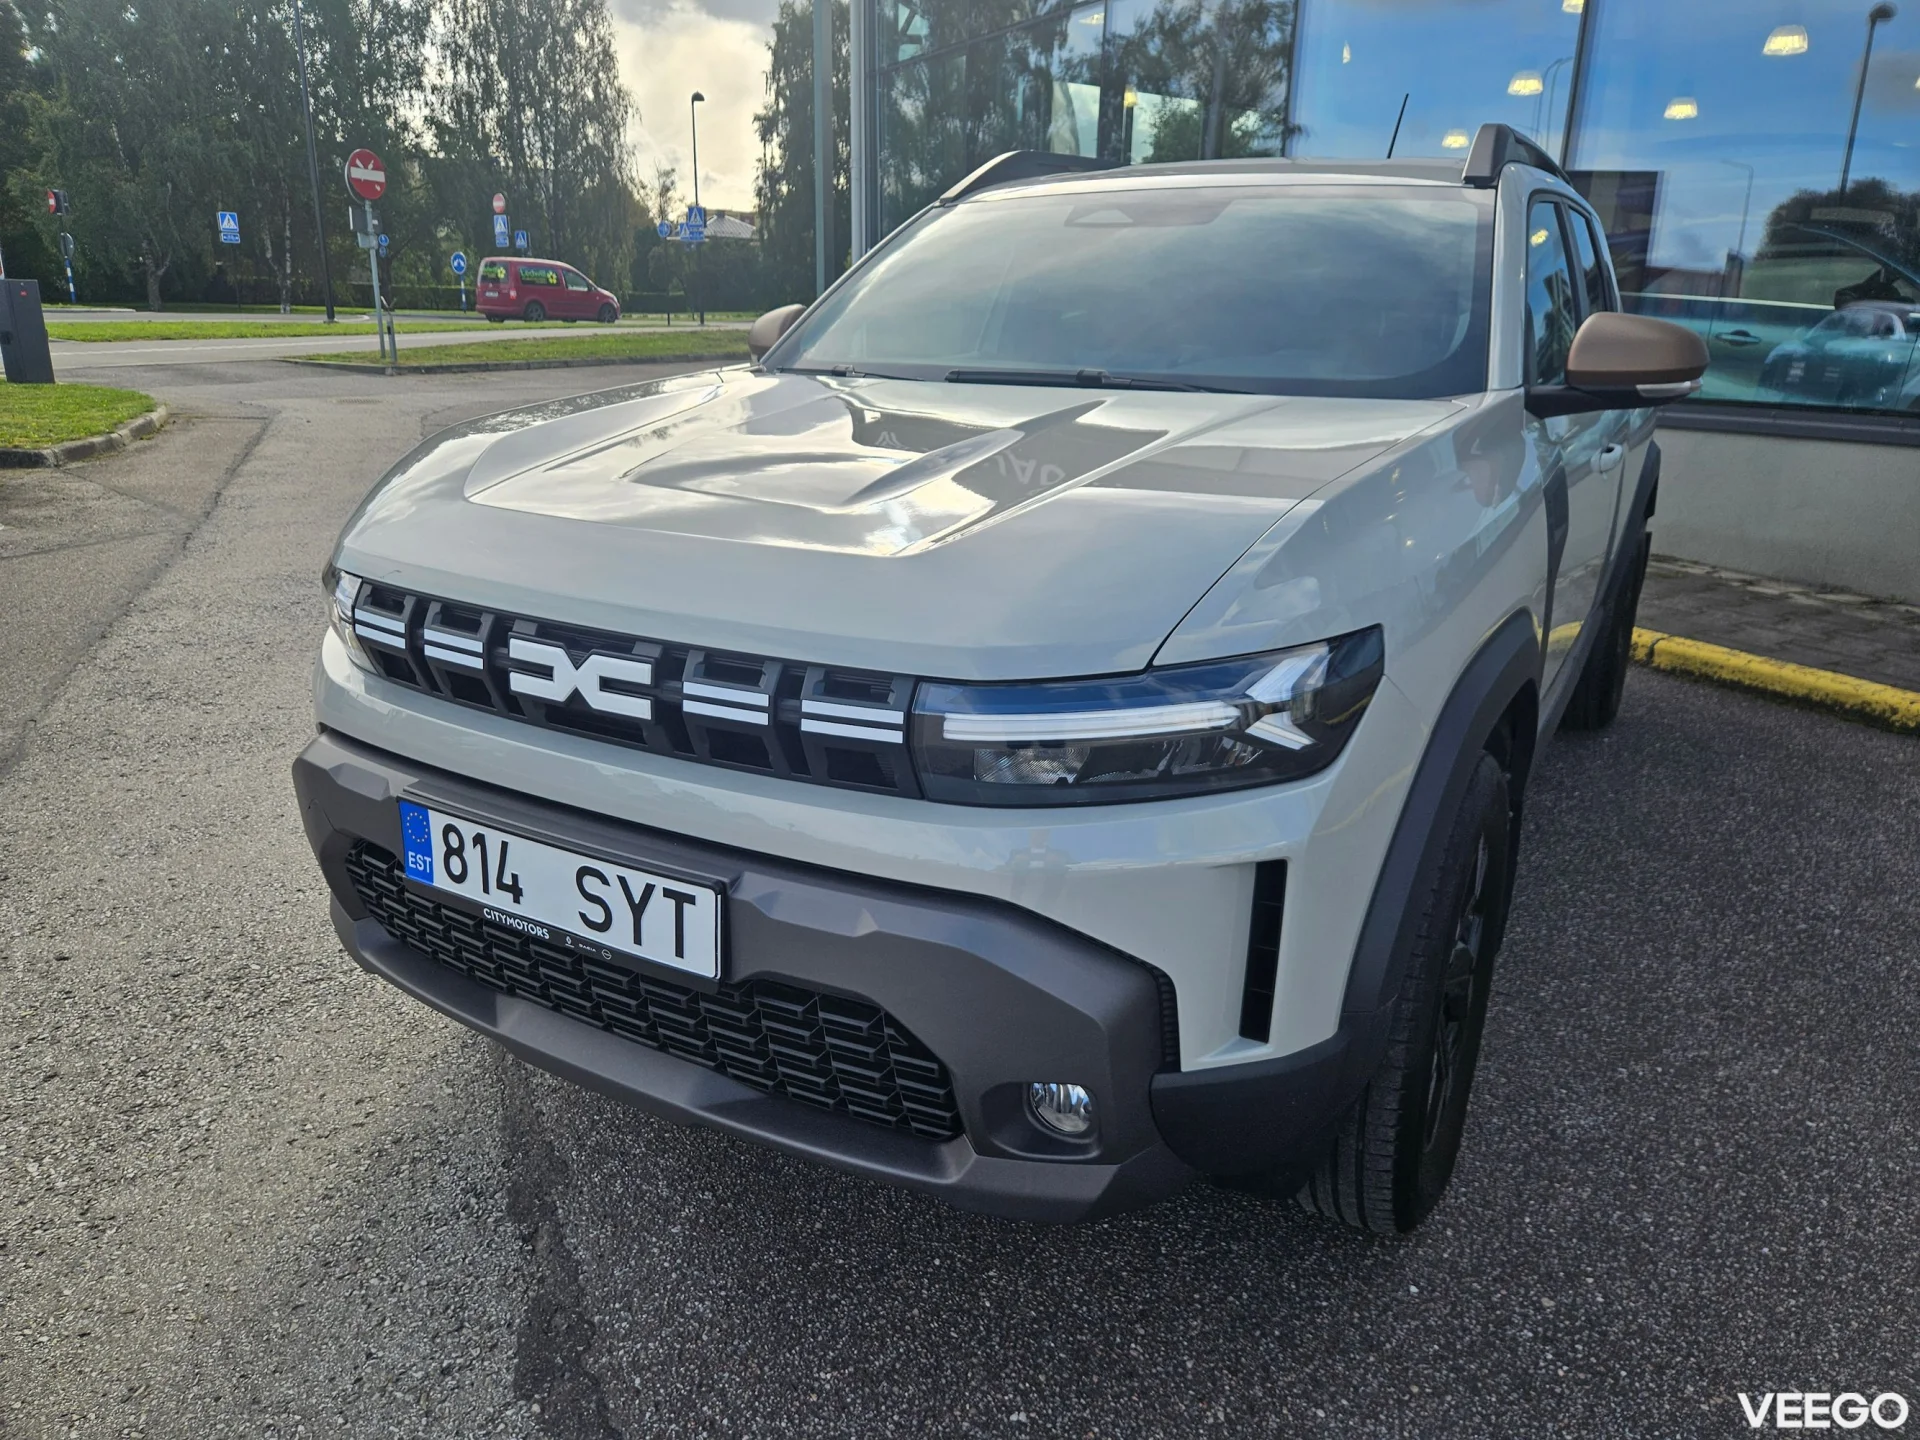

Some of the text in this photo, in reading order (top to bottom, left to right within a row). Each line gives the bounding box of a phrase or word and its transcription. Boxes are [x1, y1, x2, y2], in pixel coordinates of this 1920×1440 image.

[408, 851, 432, 873] EST
[442, 823, 696, 959] 814 SYT
[483, 908, 550, 940] CITYMOTORS
